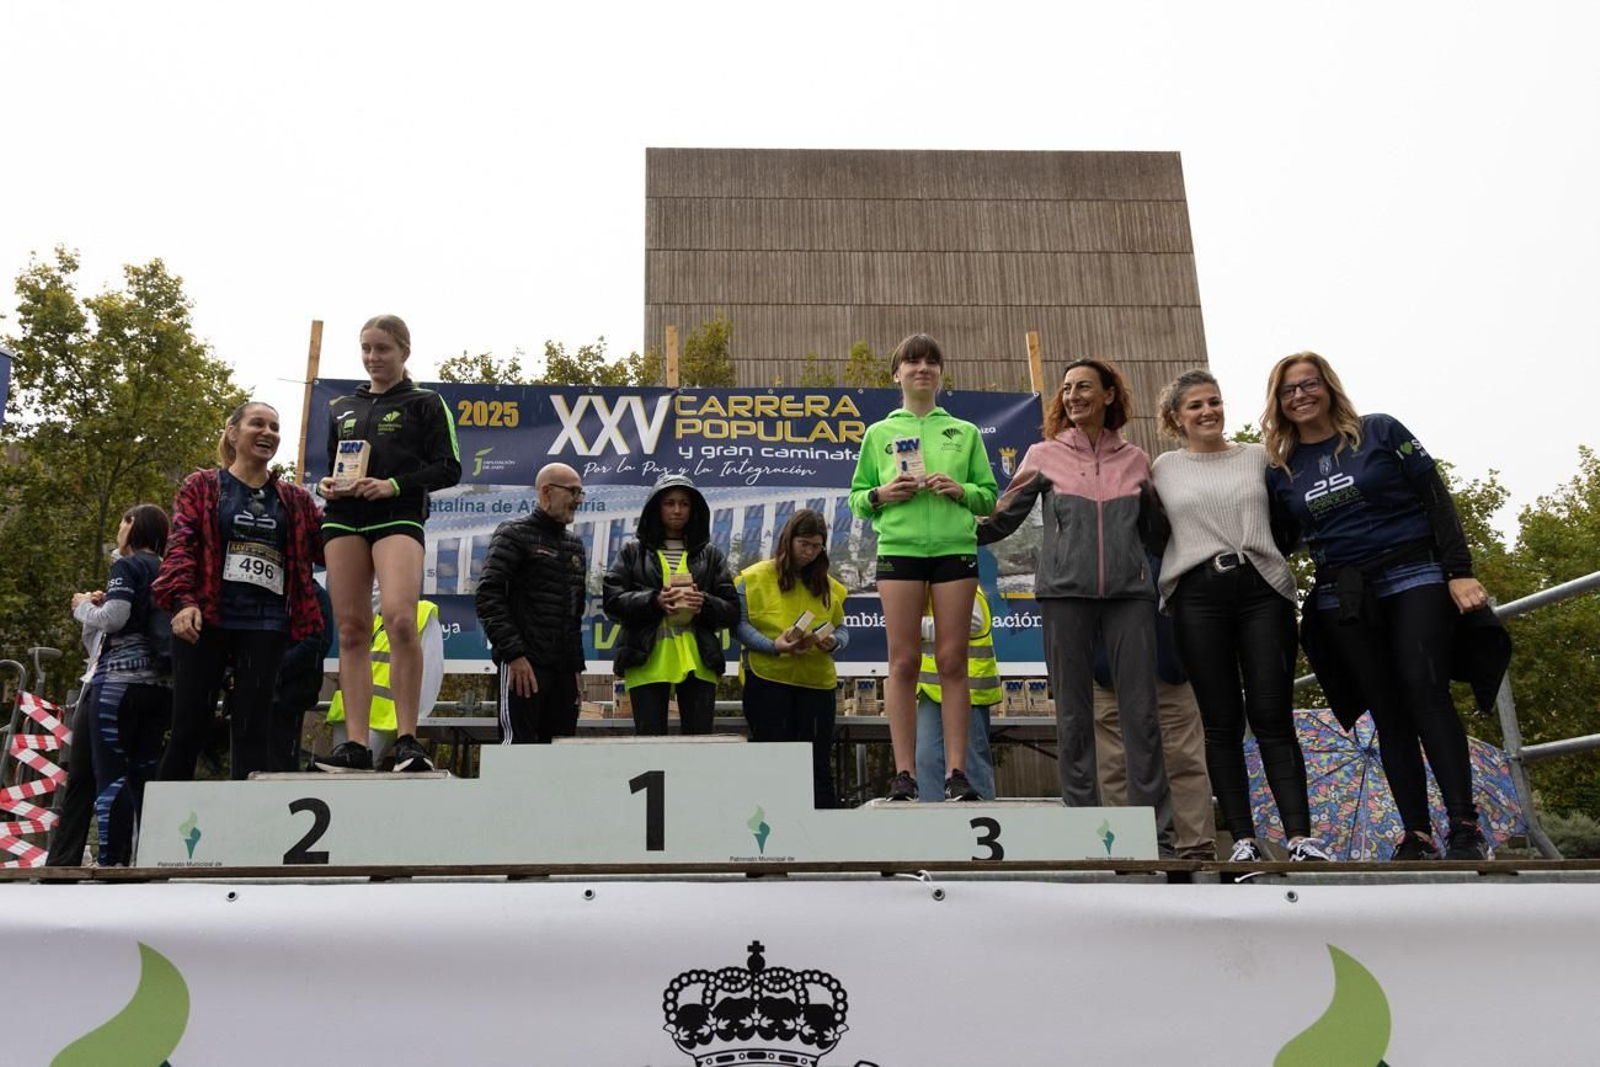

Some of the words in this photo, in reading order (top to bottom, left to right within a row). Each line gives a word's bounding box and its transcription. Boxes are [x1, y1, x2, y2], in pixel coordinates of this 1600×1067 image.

[458, 400, 519, 428] 2025
[675, 395, 861, 418] CARRERA
[547, 394, 672, 456] XXV
[675, 419, 866, 444] POPULAR
[339, 442, 364, 454] XXV
[678, 446, 693, 459] y
[701, 445, 753, 461] gran
[895, 438, 920, 453] XXV
[583, 462, 612, 477] Por
[616, 457, 636, 473] la
[642, 461, 672, 476] Paz
[694, 459, 713, 476] la
[718, 458, 817, 485] Integración
[1305, 472, 1355, 502] 25
[429, 498, 486, 513] atalina
[492, 499, 513, 514] de
[239, 558, 275, 580] 496
[843, 612, 887, 627] mbia
[992, 611, 1043, 628] ación
[629, 770, 665, 851] 1
[283, 797, 331, 865] 2
[970, 817, 1004, 861] 3
